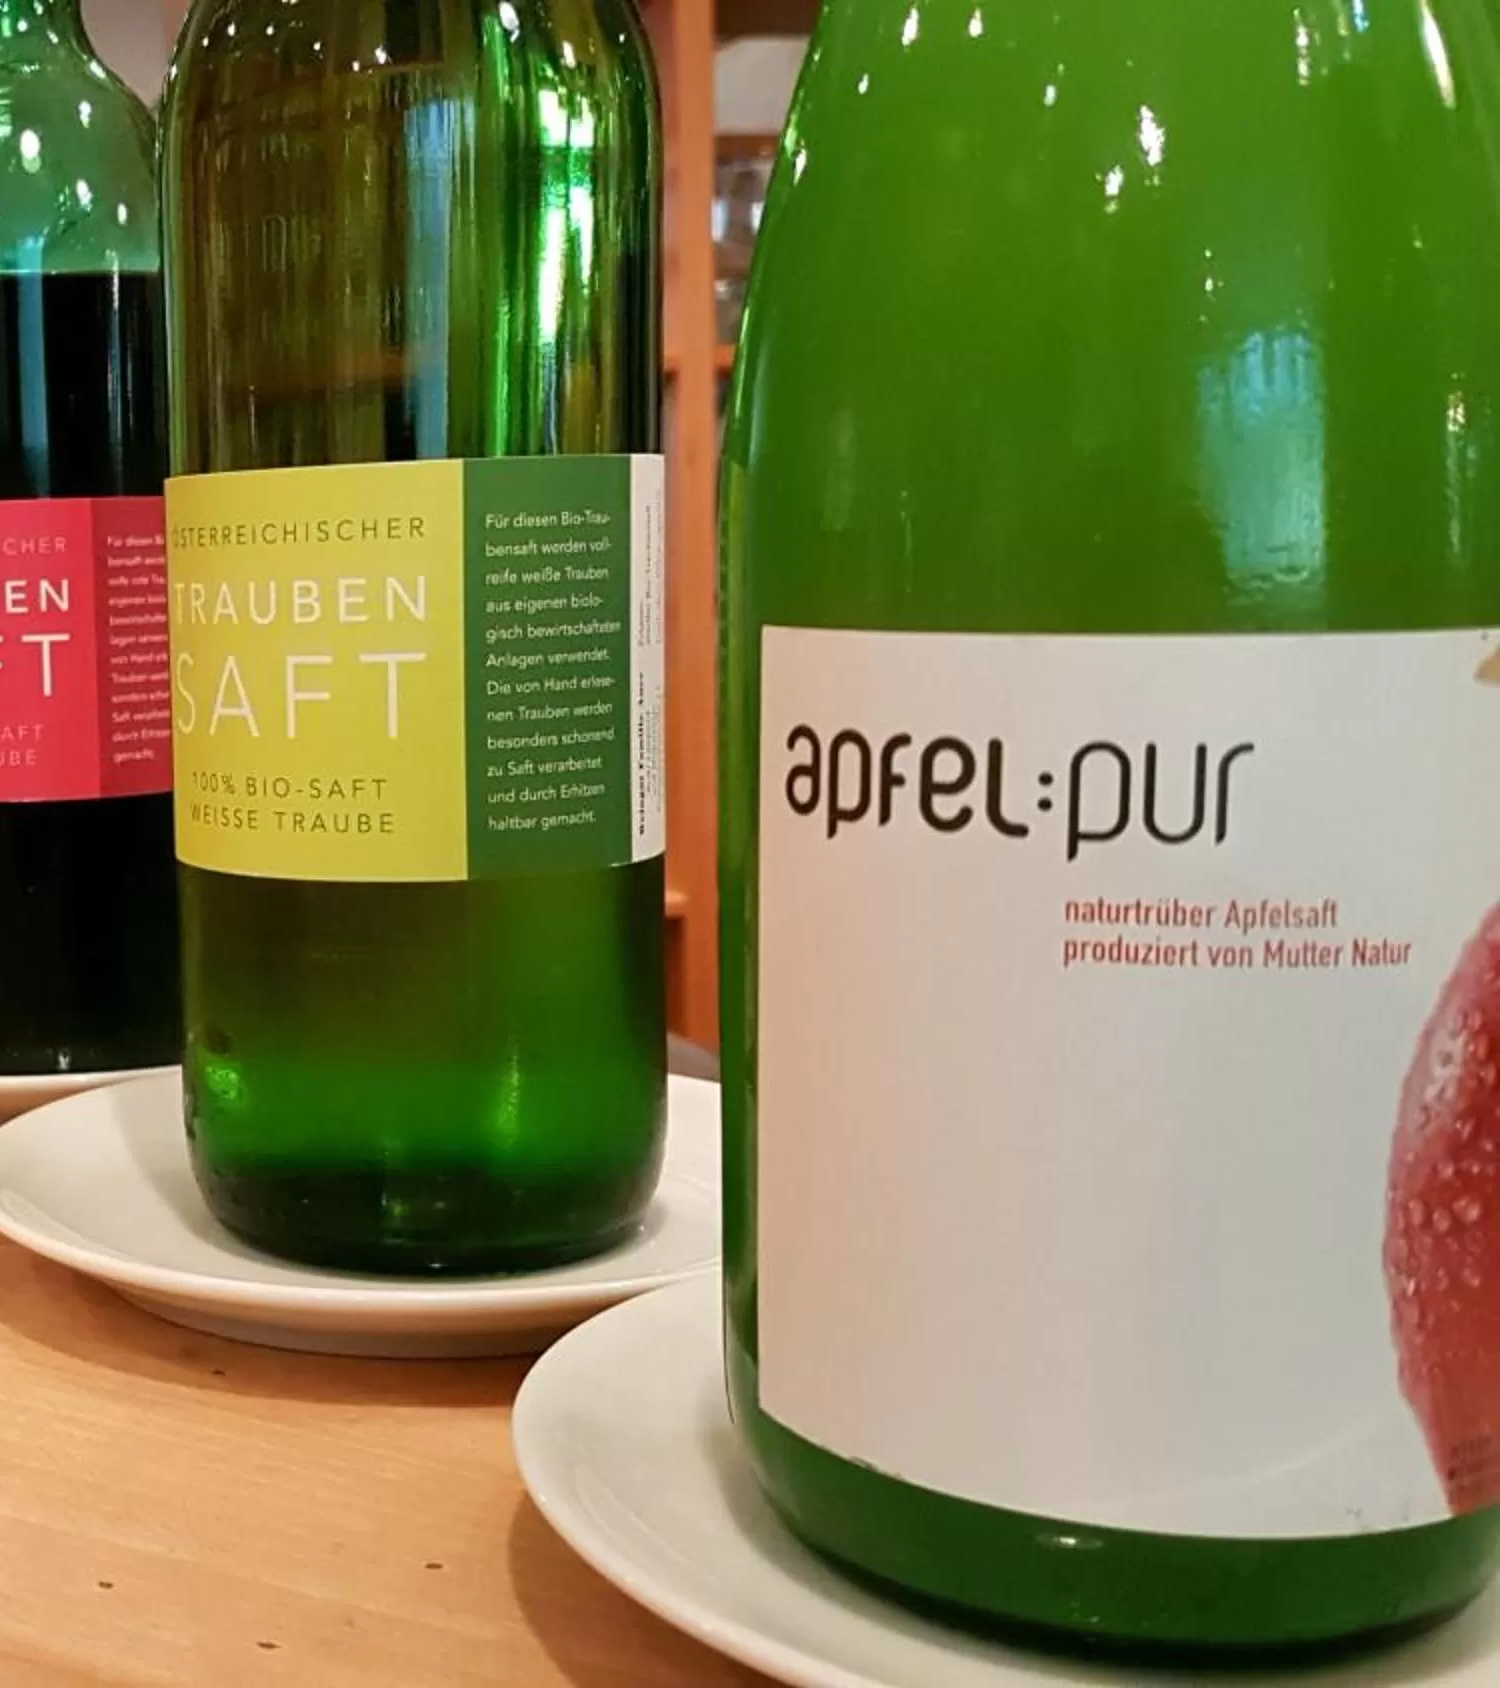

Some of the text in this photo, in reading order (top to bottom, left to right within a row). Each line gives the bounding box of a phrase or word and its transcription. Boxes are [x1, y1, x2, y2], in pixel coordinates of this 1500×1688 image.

[485, 512, 509, 529] Für
[513, 512, 557, 528] diesen
[172, 517, 426, 549] ÖSTERREICHISCHER
[485, 540, 538, 557] bensaft
[541, 538, 587, 554] werden
[485, 565, 610, 585] reife weiße Trauben
[173, 575, 426, 625] TRAUBEN
[485, 600, 511, 613] aus
[514, 596, 568, 615] eigenen
[485, 624, 524, 644] gisch
[485, 652, 544, 670] Anlagen
[176, 652, 427, 739] SAFT
[486, 680, 512, 695] Die
[515, 681, 541, 694] von
[544, 675, 578, 692] Hand
[487, 700, 613, 722] nen Trauben werden
[487, 726, 616, 750] besonders schonend
[487, 756, 603, 777] zu Saft verarbeitet
[192, 771, 388, 801] 100% BIO-SAFT
[487, 782, 606, 803] und durch Erhitzen
[190, 802, 395, 834] WEISSE TRAUBE
[488, 810, 597, 832] haltbar gemacht.
[1064, 896, 1338, 936] naturtrüber Apfelsaft
[1062, 935, 1413, 969] produziert von Mutter Natur
